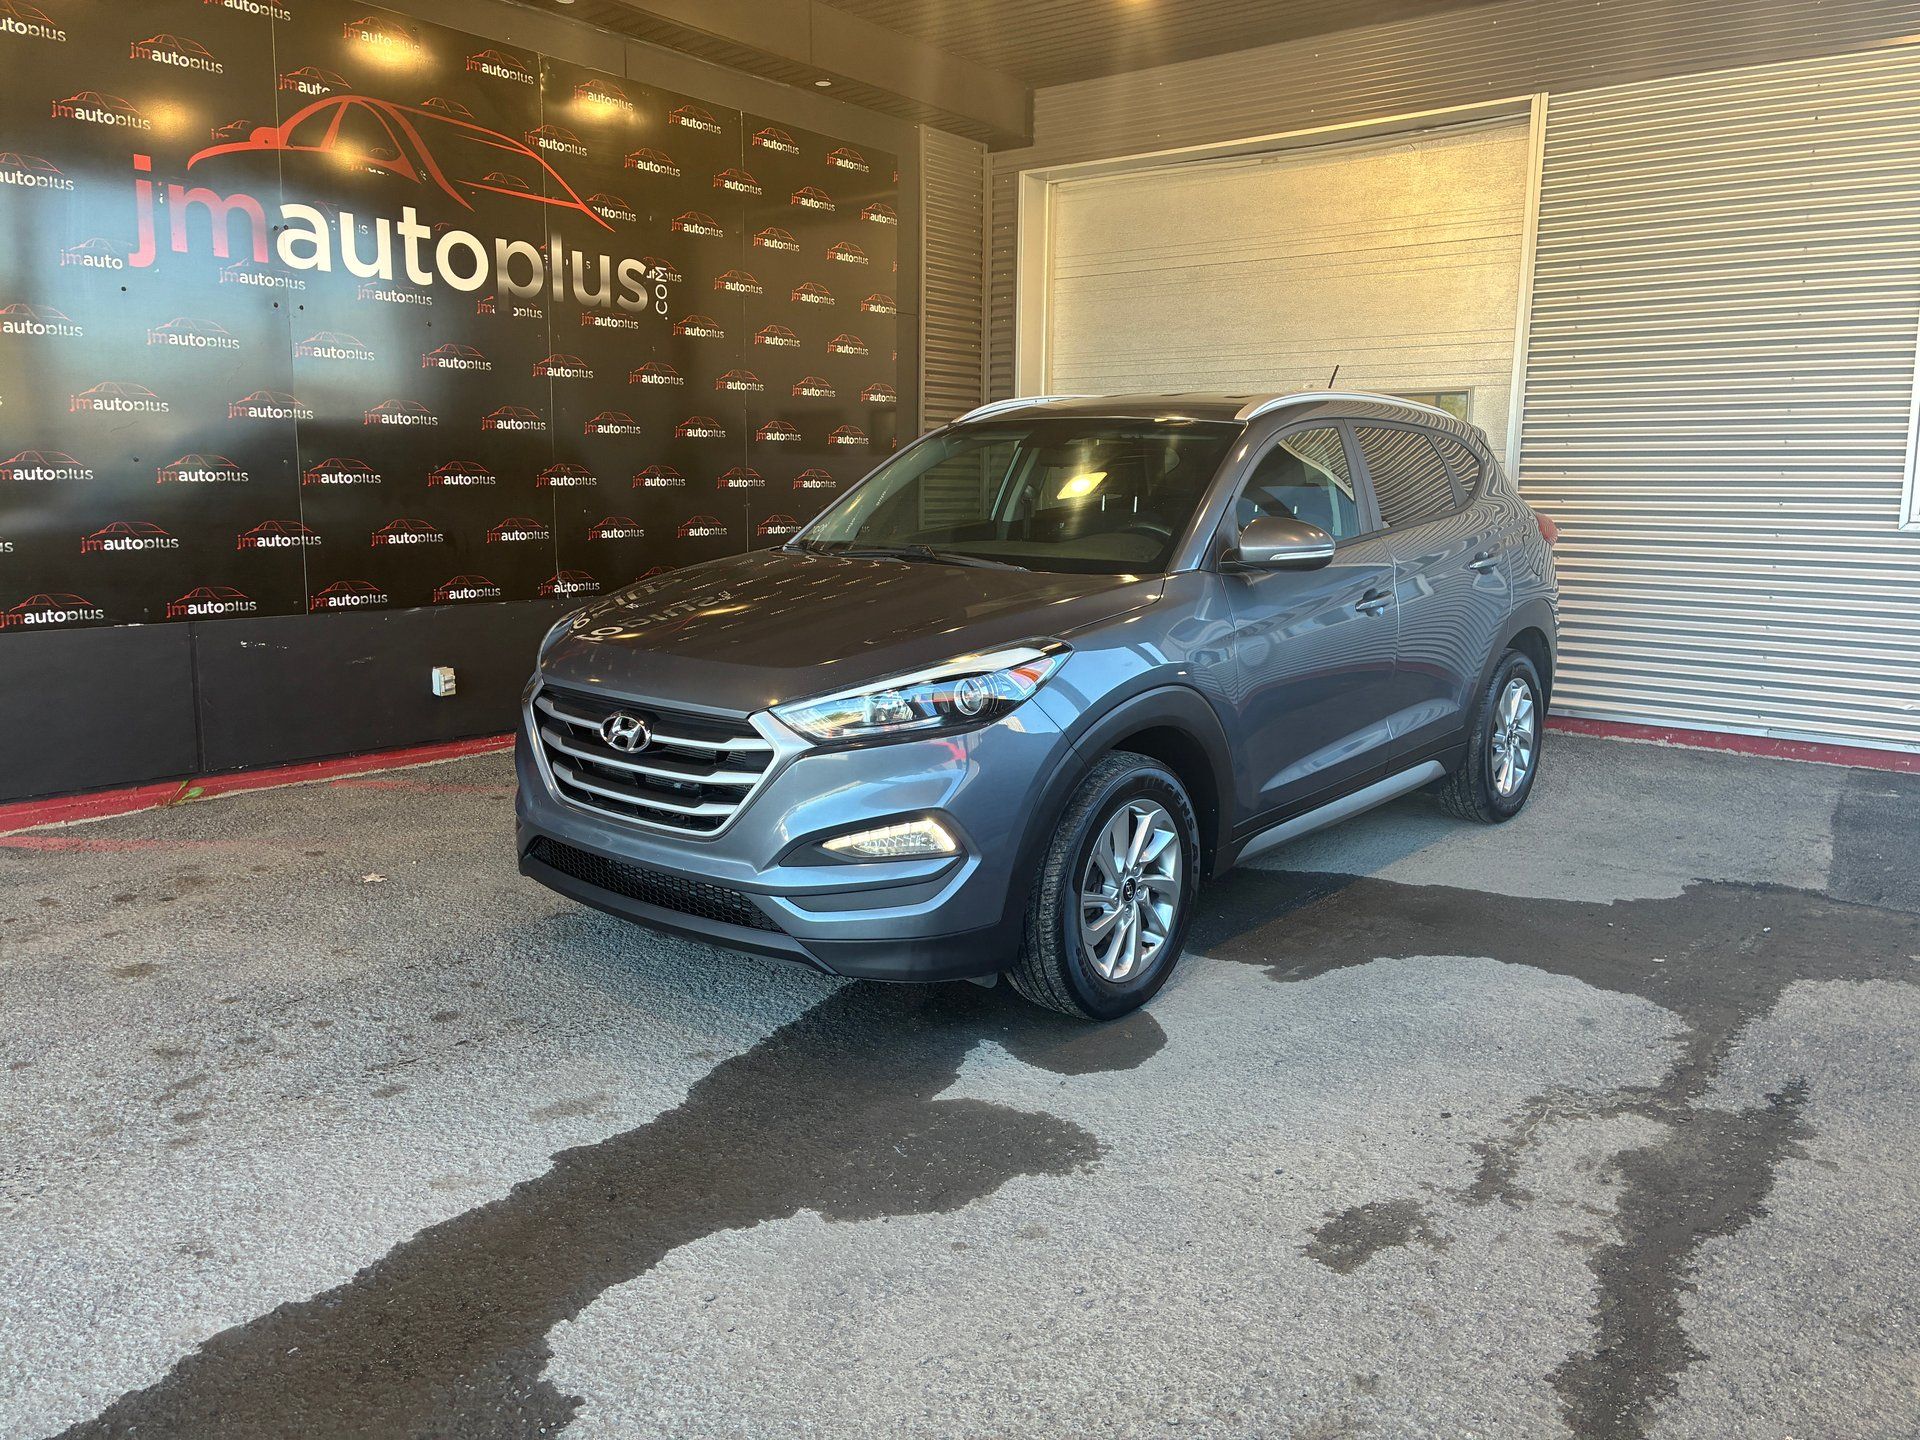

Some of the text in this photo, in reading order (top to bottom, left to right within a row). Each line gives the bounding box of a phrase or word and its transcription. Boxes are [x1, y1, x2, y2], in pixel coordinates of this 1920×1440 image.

[203, 0, 291, 21] autoplus
[130, 42, 224, 74] jmautoplus
[466, 56, 534, 85] jmautoplus
[52, 100, 151, 130] jmautoplus
[668, 111, 721, 134] jmautoplus
[752, 133, 800, 155] jmautoplus
[624, 155, 681, 178] jmautoplus
[826, 153, 869, 173] jmautoplus
[713, 175, 762, 195] jmautoplus
[791, 193, 836, 212] jmautoplus
[128, 154, 648, 312] jmautoplus
[671, 219, 724, 238] jmautoplus
[753, 234, 800, 252] jmautoplus
[60, 249, 123, 270] jmauto
[827, 249, 869, 265] jmautoplus
[219, 267, 306, 291] jmautoplus
[714, 278, 763, 295] jmautoplus
[357, 285, 433, 306] jmautoplus
[791, 289, 835, 306] jmautoplus
[0, 320, 84, 338] autoplus
[581, 312, 639, 330] jmautoplus
[146, 329, 240, 350] jmautoplus
[673, 323, 725, 340] jmautoplus
[754, 333, 800, 348] jmautoplus
[827, 341, 869, 356] jmautoplus
[294, 343, 375, 362] jmautoplus
[422, 353, 492, 371] jmautoplus
[532, 363, 594, 379] jmautoplus
[628, 371, 684, 386] jmautoplus
[715, 378, 764, 393] jmautoplus
[792, 385, 836, 398] jmautoplus
[69, 394, 170, 413] jmautoplus
[227, 402, 314, 420] jmautoplus
[363, 410, 438, 426] jmautoplus
[481, 416, 546, 431] jmautoplus
[583, 421, 641, 435] jmautoplus
[675, 426, 726, 439] jmautoplus
[755, 429, 801, 442] jmautoplus
[828, 433, 869, 445] jmautoplus
[156, 467, 249, 484] jmautoplus
[302, 470, 382, 486] jmautoplus
[427, 472, 496, 487] jmautoplus
[536, 474, 597, 488] jmautoplus
[632, 475, 686, 488] jmautoplus
[717, 477, 765, 489] jmautoplus
[793, 478, 836, 489] jmautoplus
[371, 532, 444, 547] jmautoplus
[486, 529, 550, 544] jmautoplus
[588, 527, 645, 541] jmautoplus
[677, 526, 727, 539] jmautoplus
[81, 536, 179, 554] jmautoplus
[237, 534, 322, 550] jmautoplus
[309, 593, 388, 611] jmautoplus
[433, 586, 501, 603] jmautoplus
[166, 599, 257, 618] jmautoplus
[0, 606, 105, 629] jmautoplus
